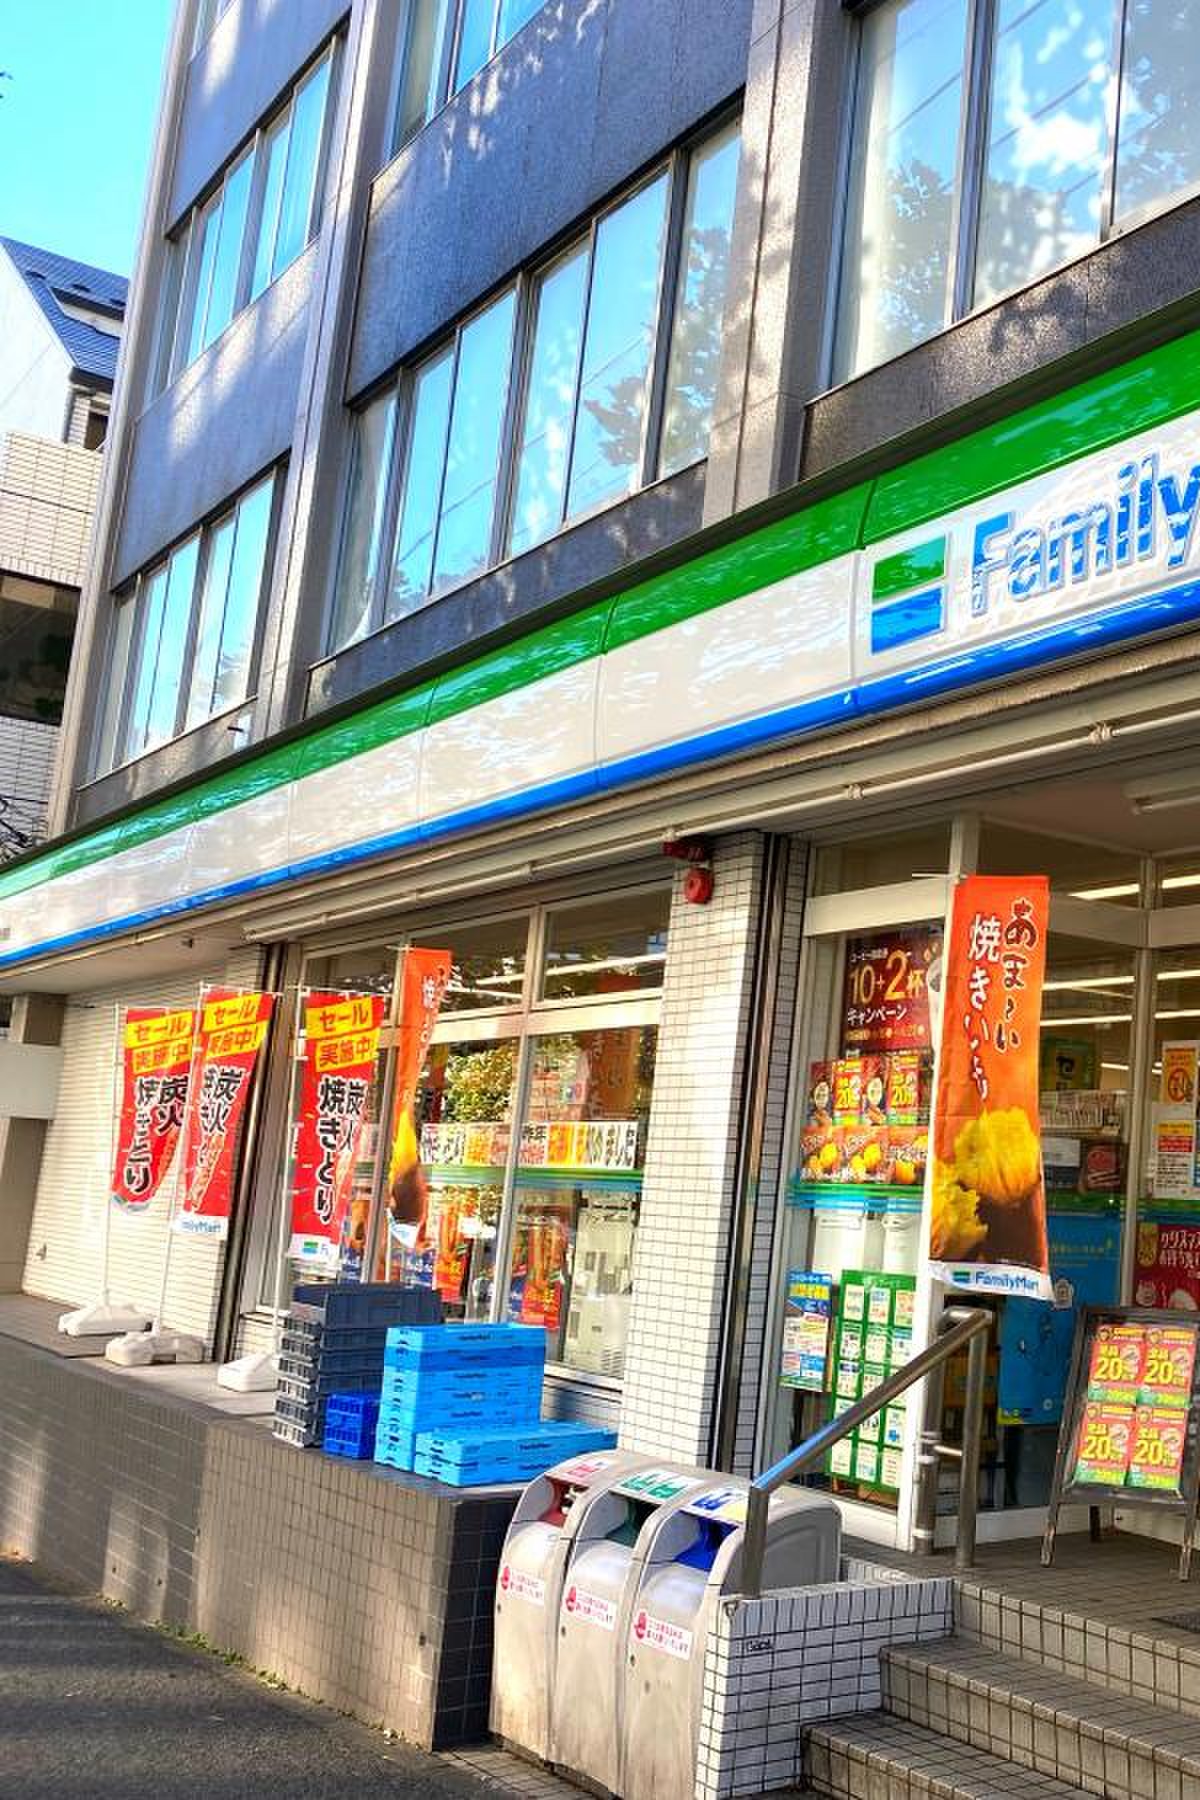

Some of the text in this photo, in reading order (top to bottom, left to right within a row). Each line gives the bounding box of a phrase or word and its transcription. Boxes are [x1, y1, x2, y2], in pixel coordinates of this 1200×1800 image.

[213, 1000, 257, 1026] セール
[319, 1005, 370, 1033] セール
[847, 1004, 908, 1026] キャンペーン
[134, 1017, 188, 1042] セール
[317, 1077, 347, 1223] 焼きとり
